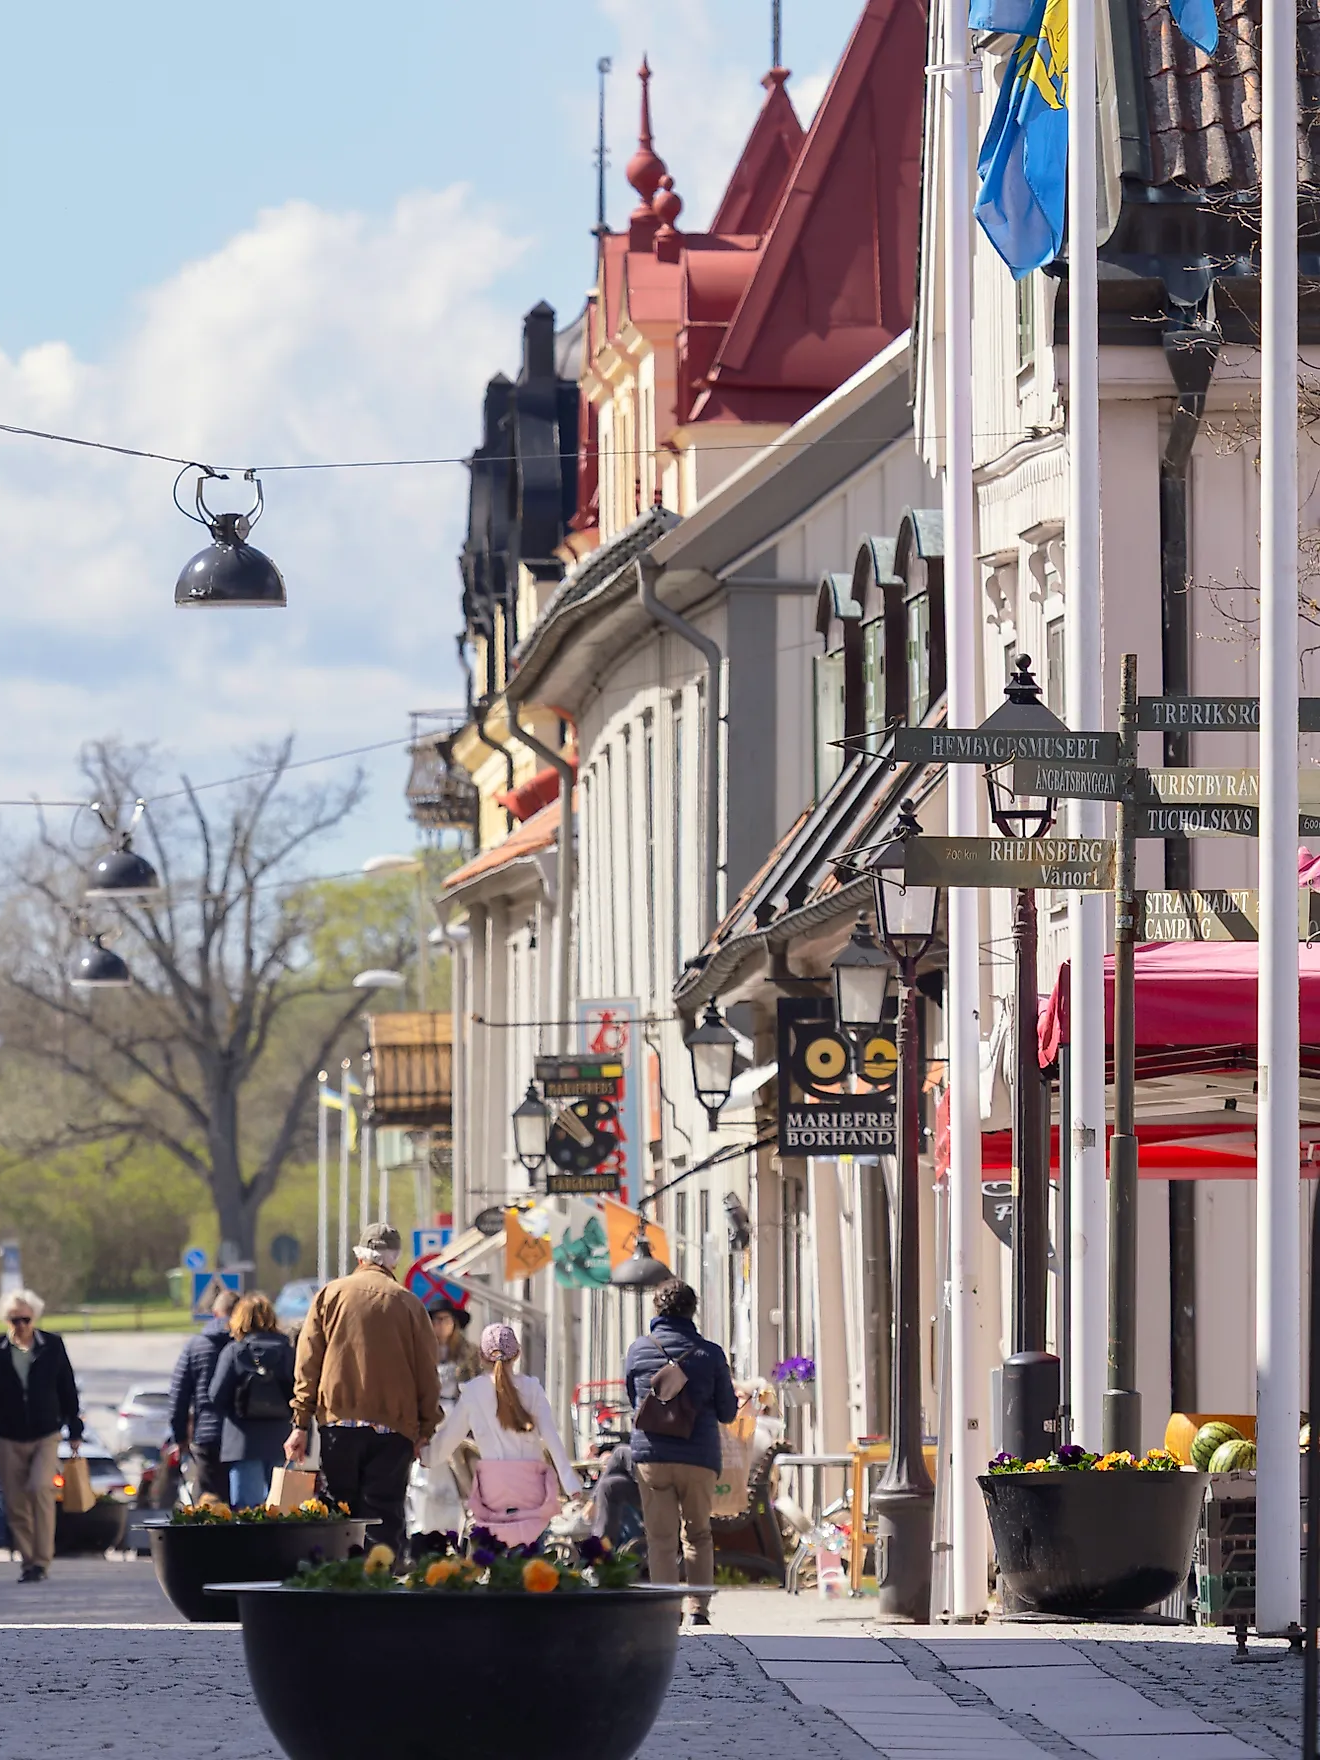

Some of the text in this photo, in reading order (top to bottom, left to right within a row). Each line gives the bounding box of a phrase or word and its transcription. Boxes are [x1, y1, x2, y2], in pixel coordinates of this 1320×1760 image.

[1153, 700, 1260, 725] TRERIKSRÖ
[931, 735, 1100, 760] HEMBYGDSMUSEET
[1035, 764, 1116, 795] ÅNGBÅTSBRYGGAN
[1147, 808, 1253, 831] TUCHOLSKYS
[990, 841, 1103, 863] RHEINSBERG
[1040, 864, 1100, 886] Vänort
[1145, 891, 1249, 914] STRANDBADET
[1145, 917, 1211, 940] CAMPING
